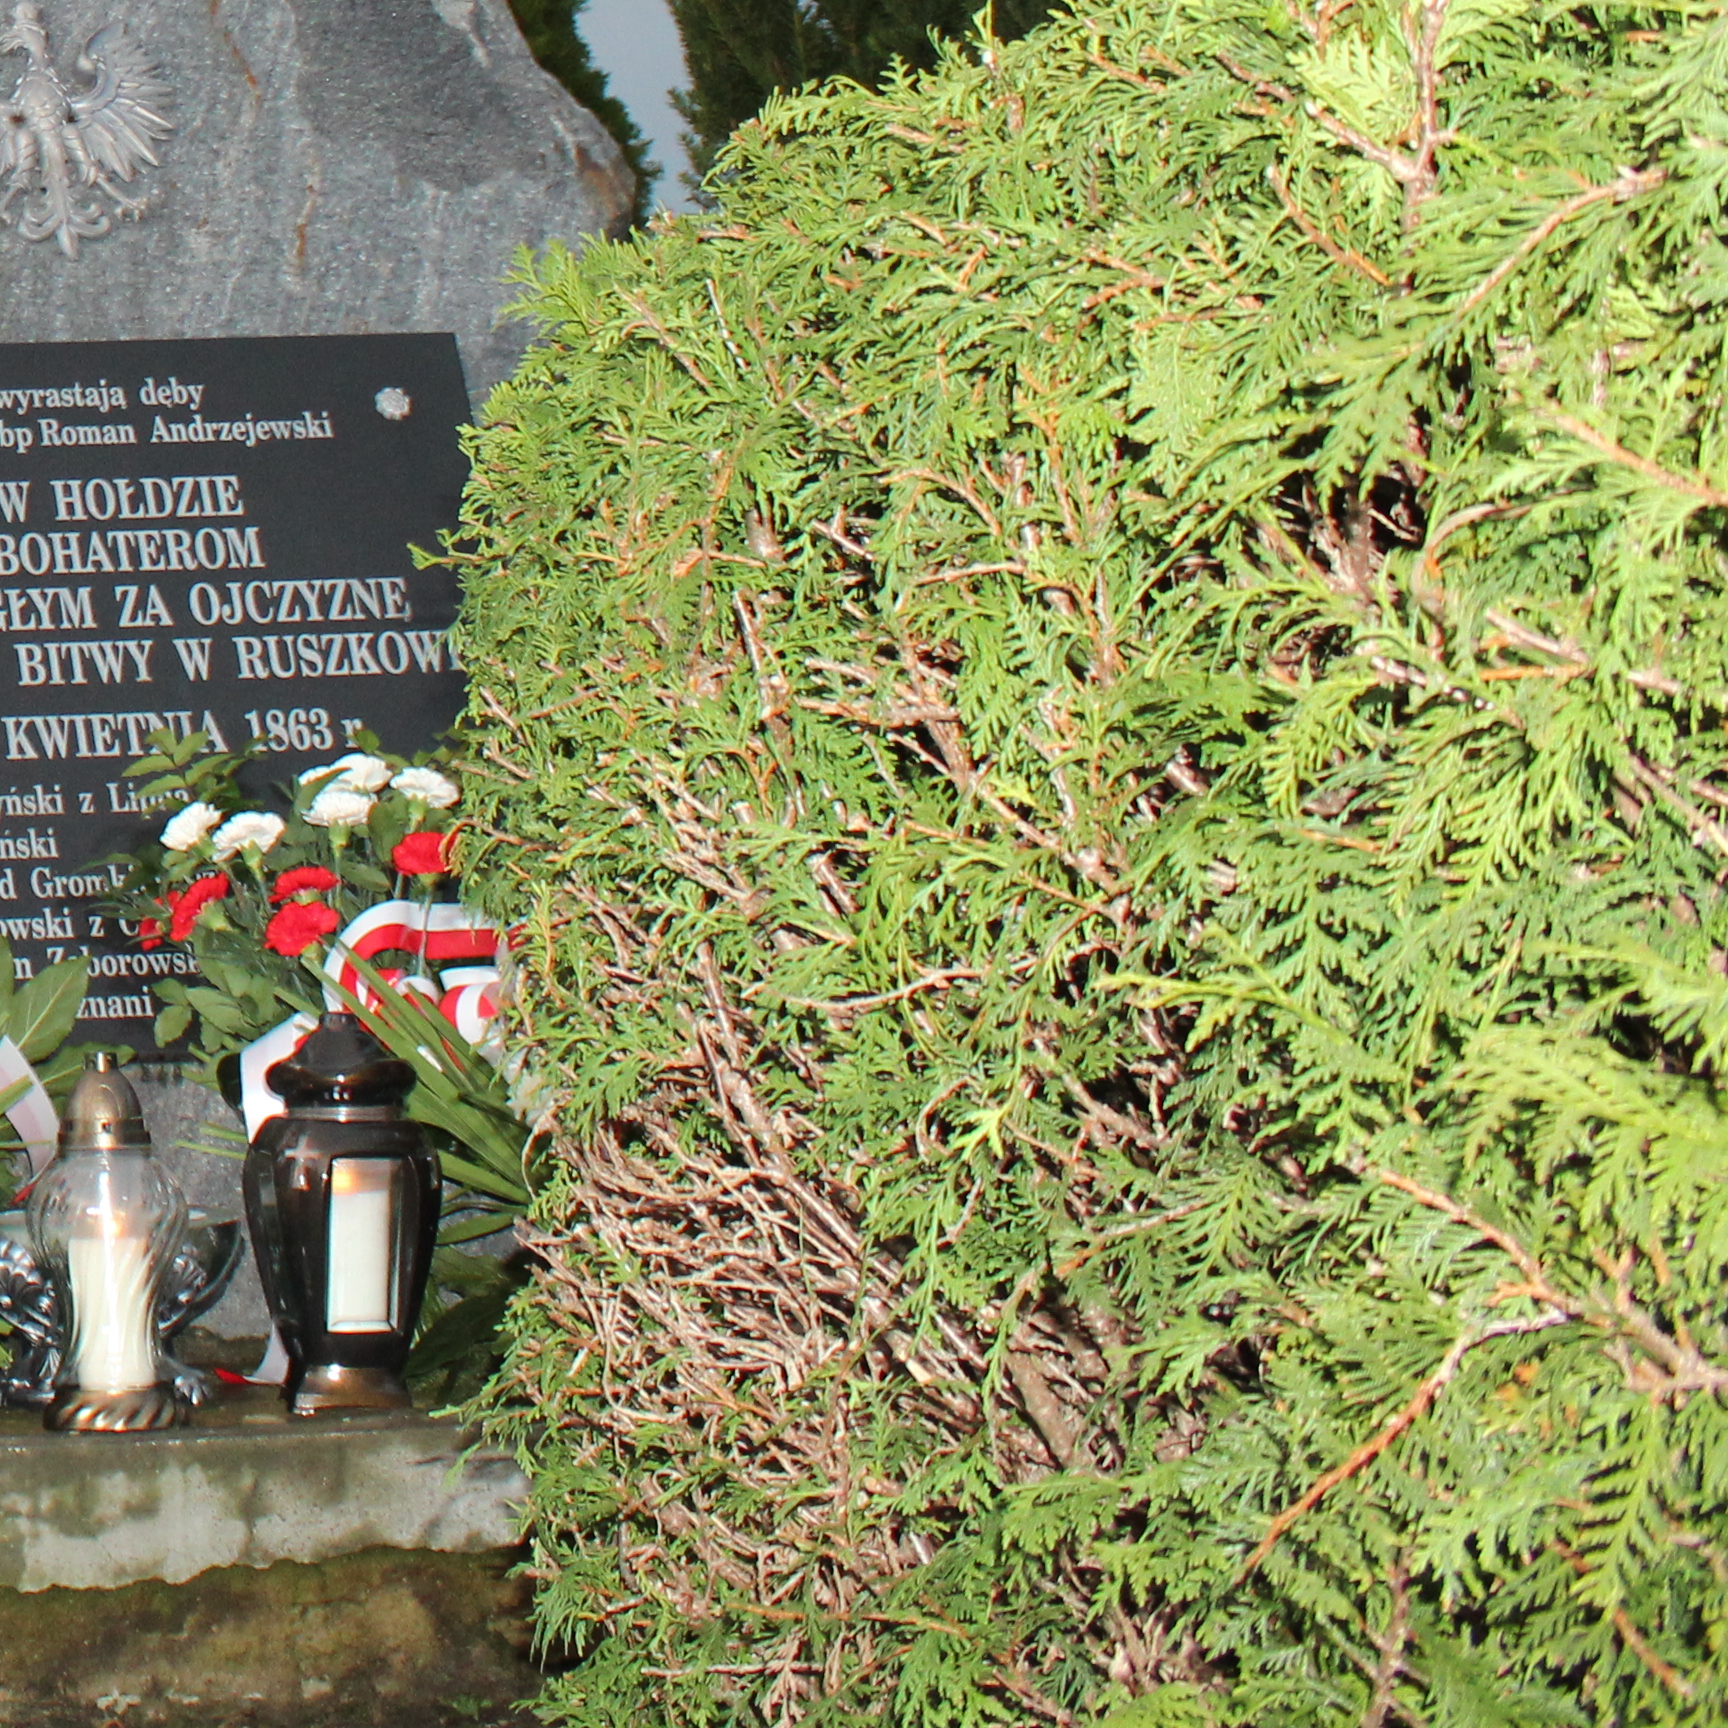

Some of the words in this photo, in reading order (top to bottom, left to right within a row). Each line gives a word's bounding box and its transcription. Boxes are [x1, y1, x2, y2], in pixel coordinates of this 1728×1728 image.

[140, 376, 204, 411] dęby
[40, 418, 137, 447] Roman
[150, 411, 333, 447] Andrzejewski
[50, 475, 244, 521] HOŁDZIE
[115, 584, 174, 628] ZA
[189, 576, 412, 625] OJCZYZNĘ
[14, 640, 153, 685] BITWY
[172, 638, 212, 681] W
[244, 707, 335, 752] 1863
[78, 791, 94, 813] z
[88, 915, 105, 937] z
